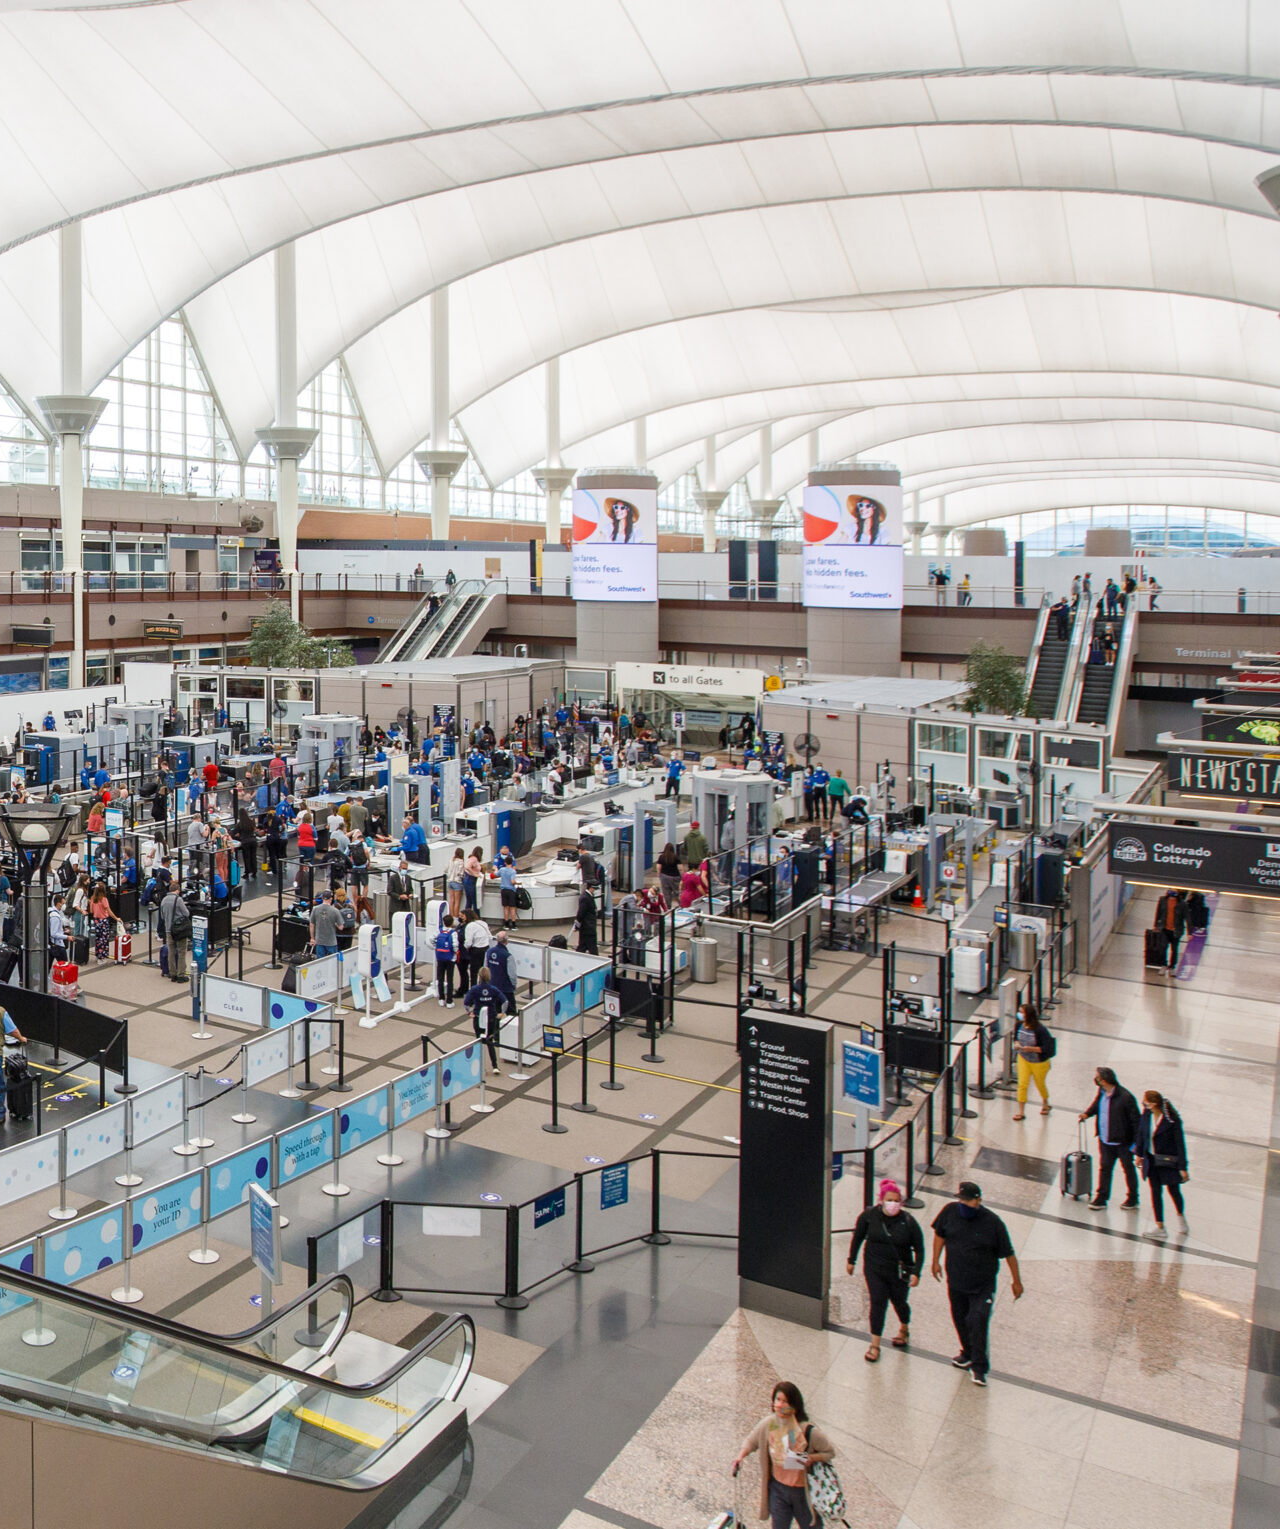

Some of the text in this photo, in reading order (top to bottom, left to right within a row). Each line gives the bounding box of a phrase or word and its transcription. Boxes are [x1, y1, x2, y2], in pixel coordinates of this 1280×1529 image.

[603, 565, 623, 573] fees.
[844, 568, 868, 577] fees.
[1175, 647, 1231, 658] Terminal
[669, 675, 723, 686] to all Gates
[1153, 843, 1212, 857] Colorado
[1153, 853, 1204, 869] Lottery
[223, 1003, 244, 1012] CLEAR
[760, 1041, 785, 1052] Ground
[759, 1057, 798, 1071] Information
[760, 1049, 810, 1065] Transportation
[759, 1068, 810, 1085] Baggage Claim
[759, 1079, 802, 1095] Westin Hotel
[759, 1090, 807, 1107] Transit Center
[787, 1108, 809, 1119] Shops
[284, 1129, 327, 1157] Speed through
[291, 1151, 305, 1165] with
[310, 1146, 320, 1157] tap
[154, 1197, 182, 1216] You are
[152, 1209, 182, 1233] your ID
